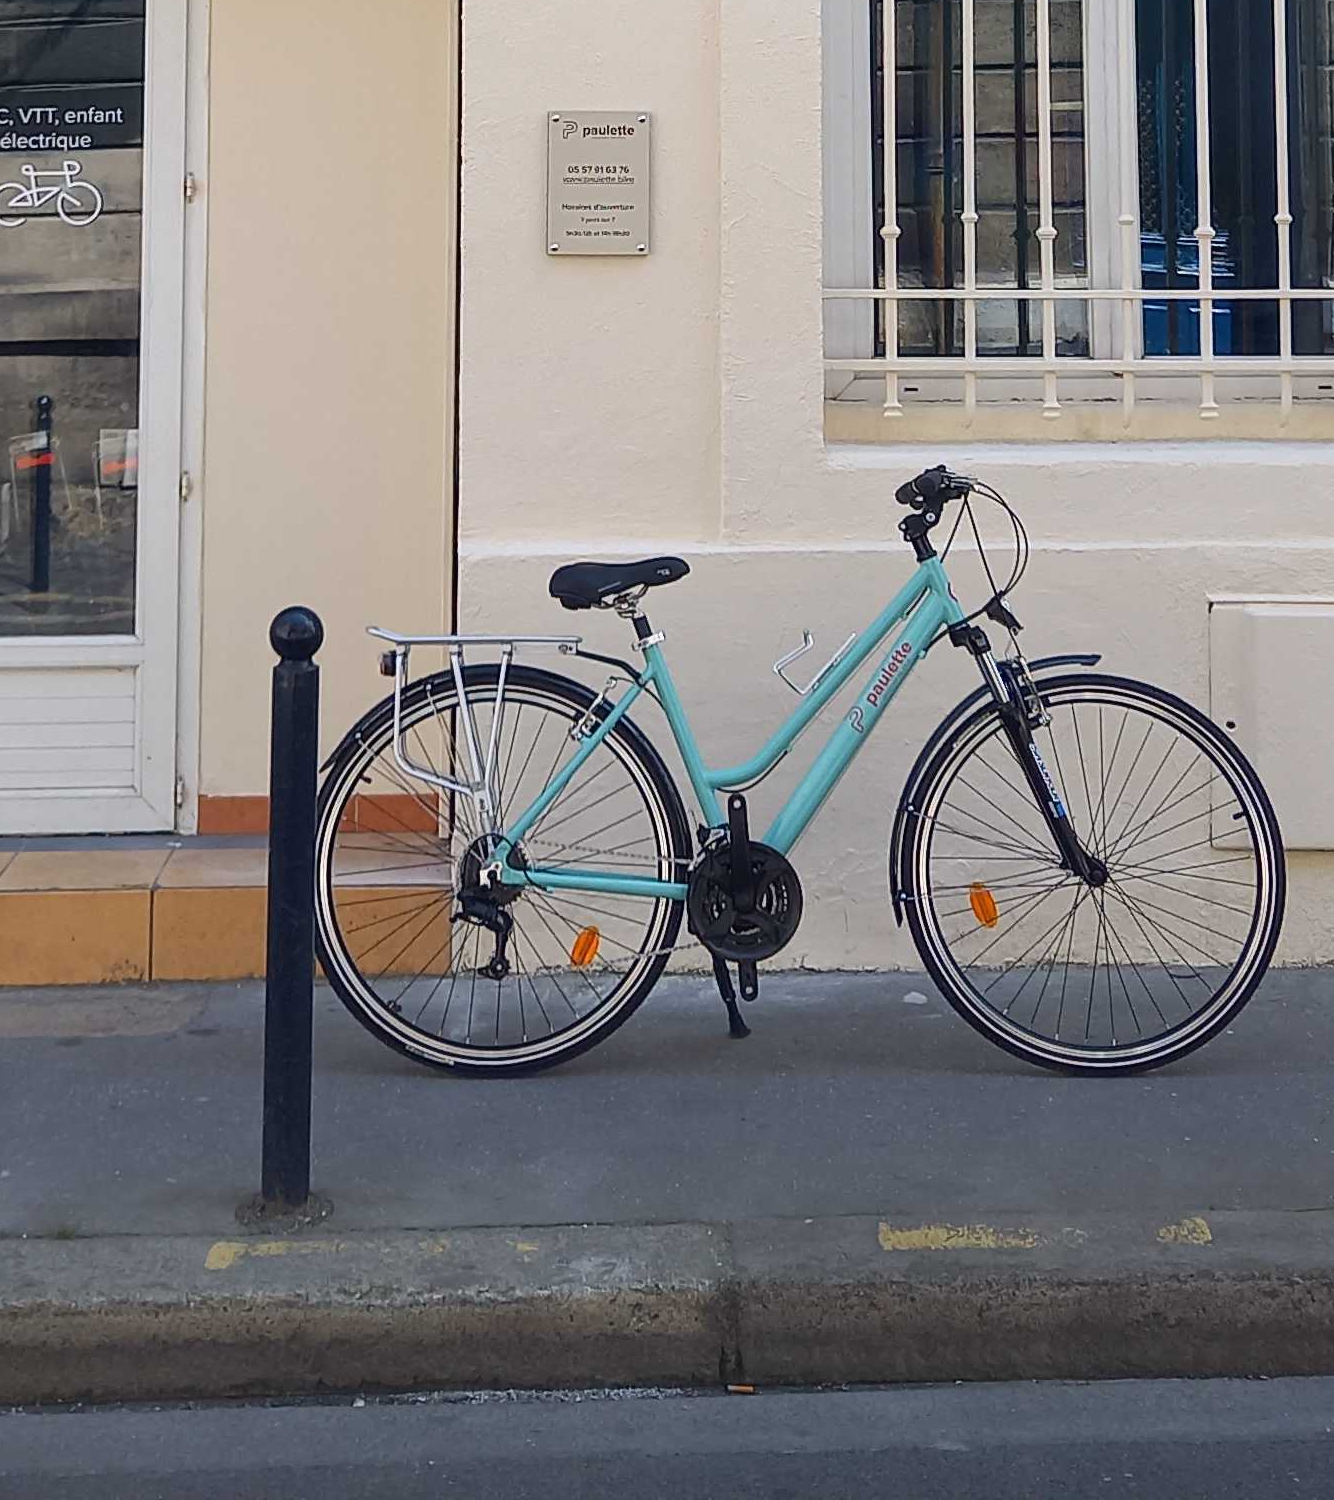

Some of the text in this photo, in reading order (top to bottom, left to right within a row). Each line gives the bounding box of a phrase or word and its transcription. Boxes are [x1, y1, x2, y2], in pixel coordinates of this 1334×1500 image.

[18, 107, 60, 126] VTT,
[64, 106, 124, 124] enfant
[0, 131, 92, 151] électrique
[582, 124, 635, 138] paulette
[867, 642, 913, 708] paulette
